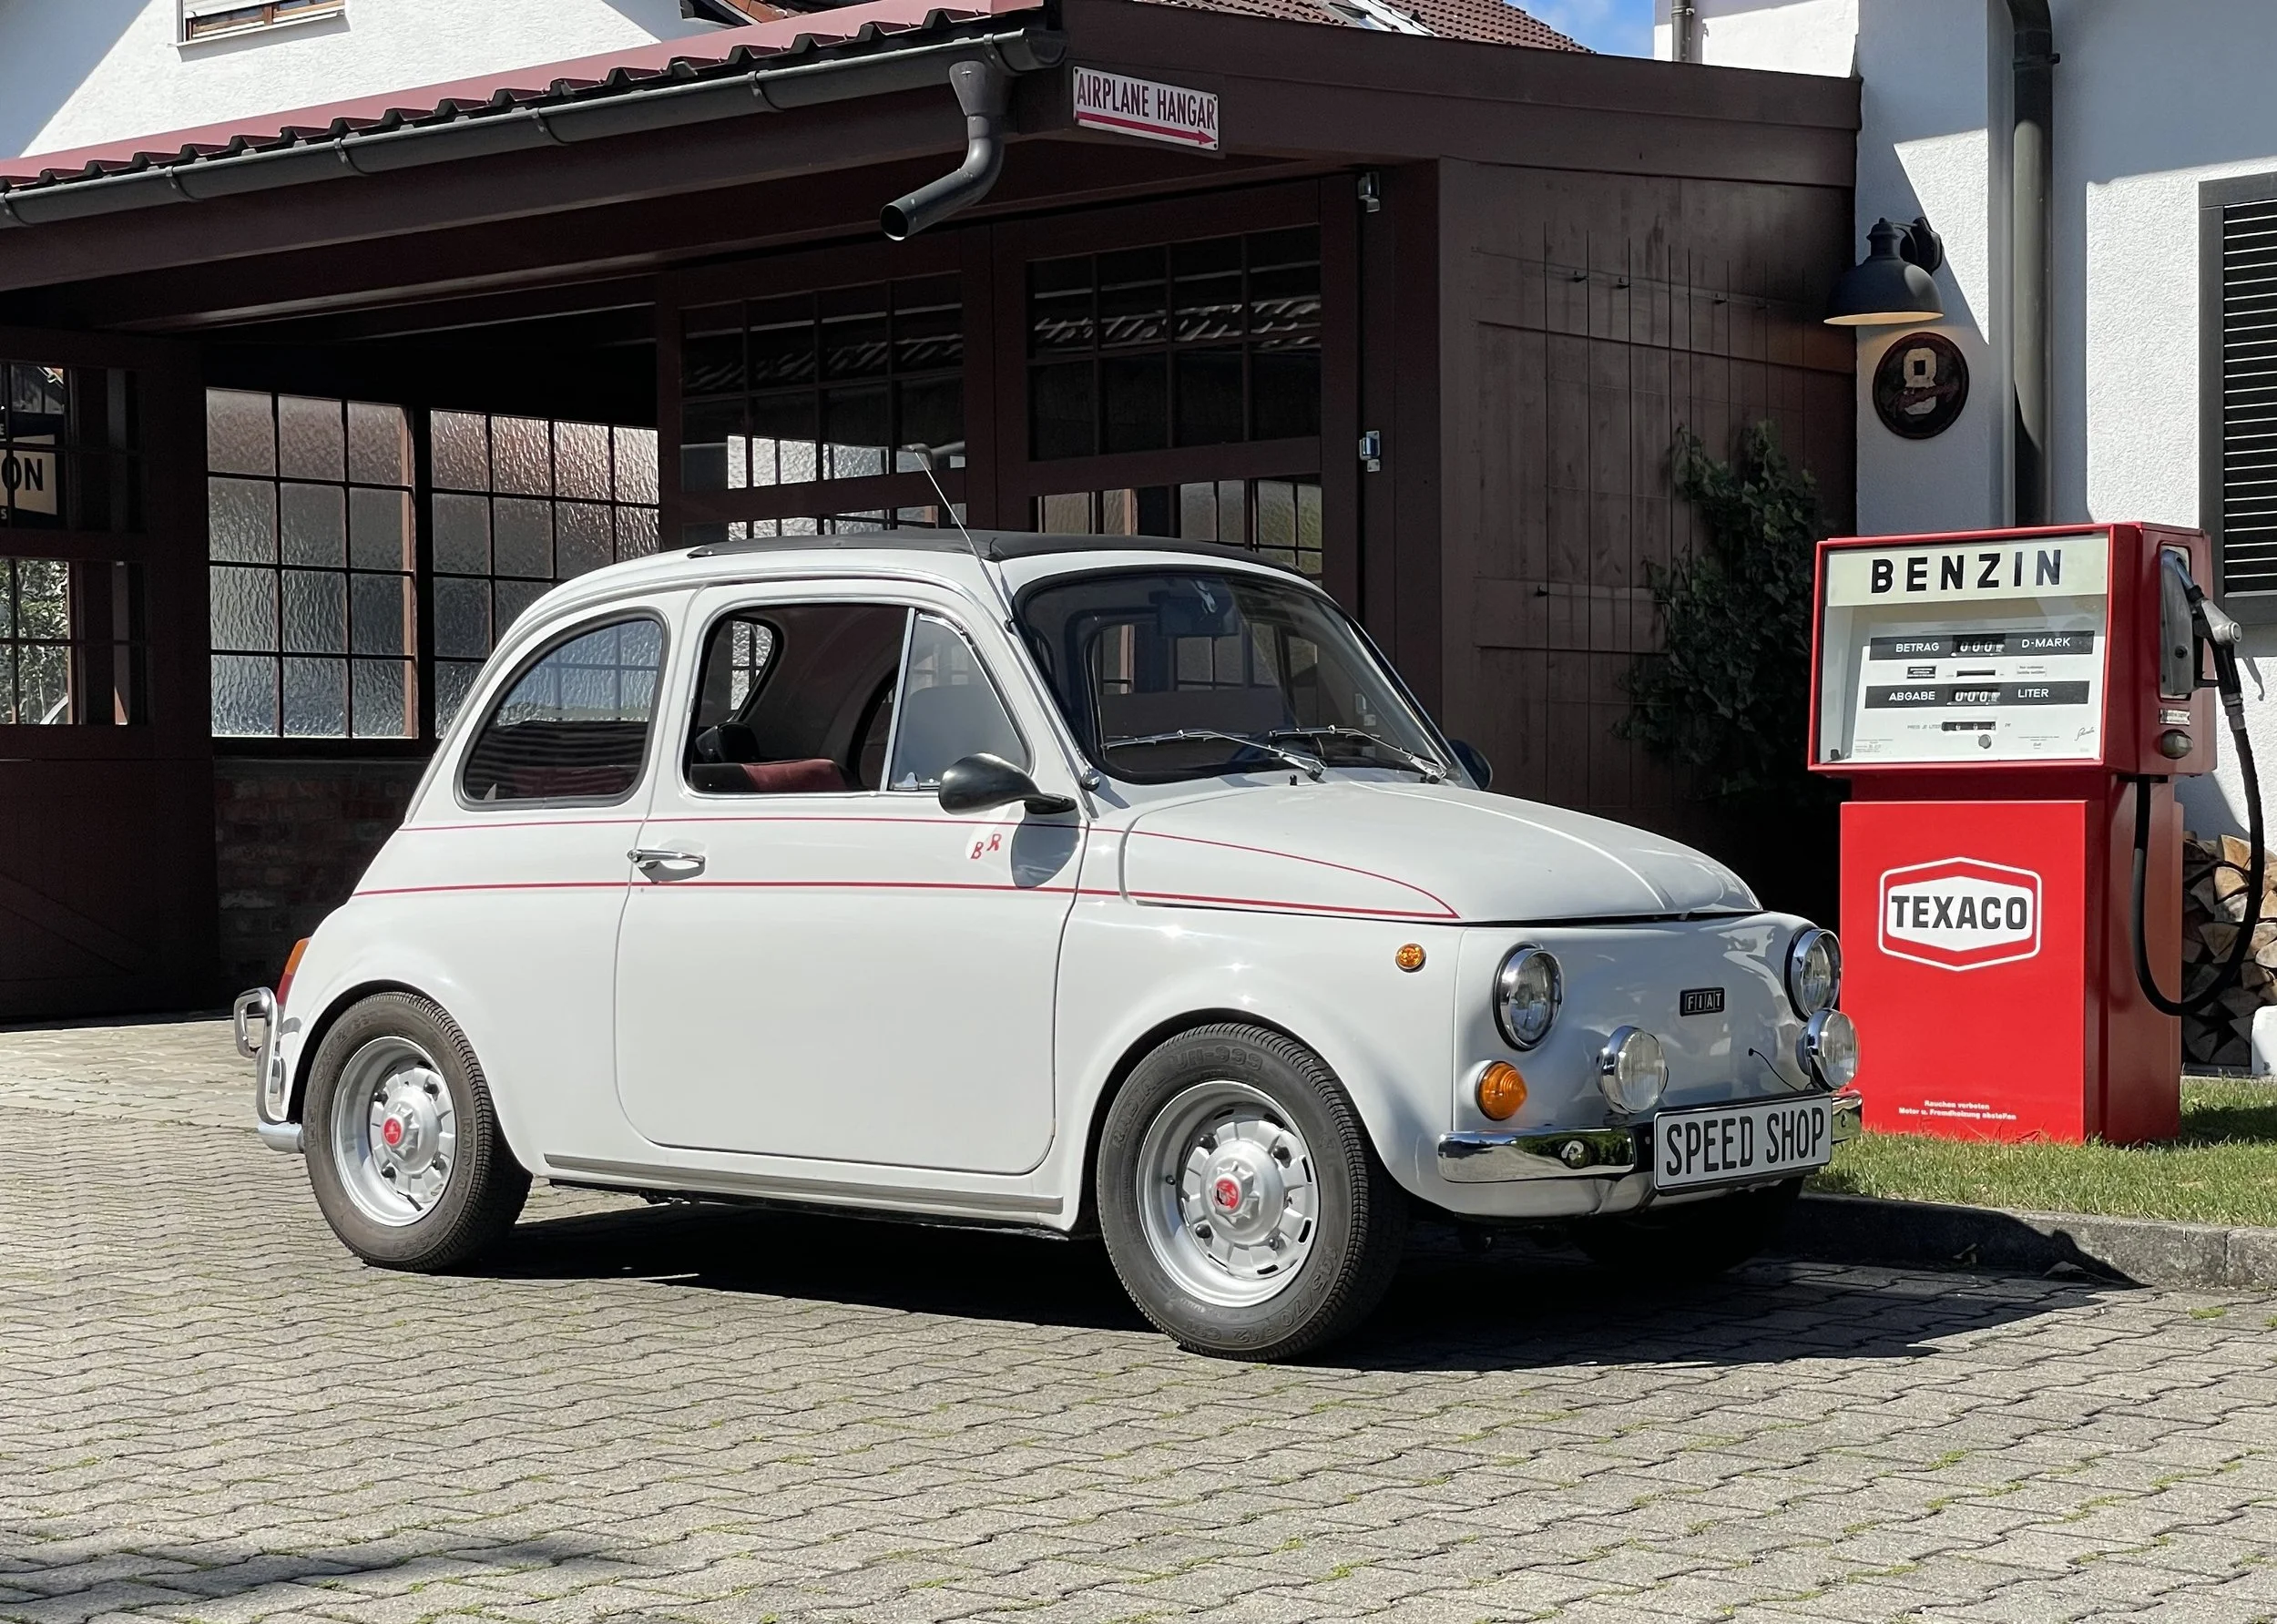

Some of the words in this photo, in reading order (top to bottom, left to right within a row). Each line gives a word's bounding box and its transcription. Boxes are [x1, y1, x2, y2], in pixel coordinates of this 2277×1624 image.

[1077, 73, 1149, 117] AIRPLANE
[1157, 88, 1216, 130] HANGAR
[1871, 549, 2061, 594] BENZIN
[1895, 642, 1940, 653] BETRAG
[2021, 638, 2071, 649] D-MARK
[1888, 690, 1936, 701] ABGABE
[2017, 688, 2049, 699] LITER
[1891, 895, 2027, 930] TEXACO
[1688, 993, 1721, 1010] FIAT
[1898, 1107, 1920, 1115] Motor
[1924, 1100, 1956, 1108] Rauchen
[1957, 1102, 1990, 1110] verboten
[1666, 1116, 1754, 1177] SPEED
[1766, 1107, 1824, 1164] SHOP
